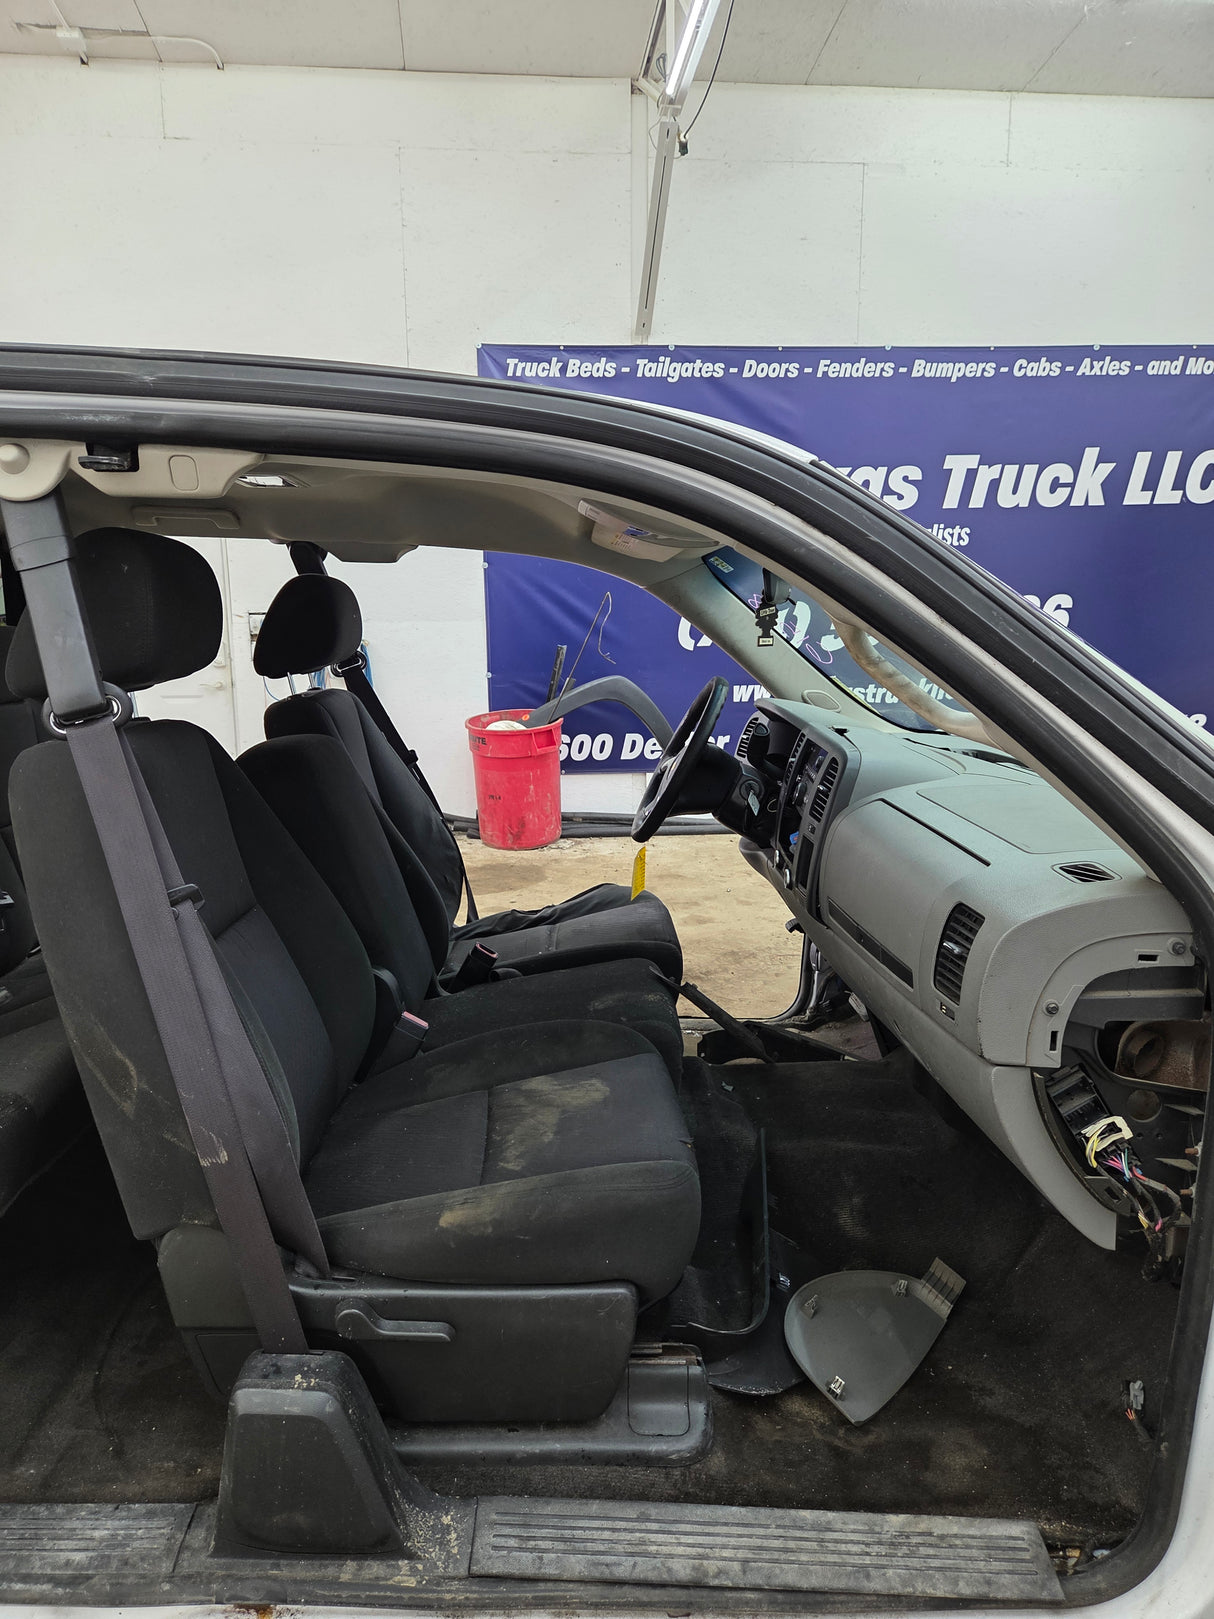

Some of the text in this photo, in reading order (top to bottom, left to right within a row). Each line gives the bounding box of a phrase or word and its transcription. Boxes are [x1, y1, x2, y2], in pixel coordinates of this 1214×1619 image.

[506, 357, 563, 378] Truck
[566, 357, 617, 378] Beds
[636, 356, 725, 383] Tailgates
[742, 359, 800, 378] Doors
[817, 358, 895, 378] Fenders
[911, 359, 996, 383] Bumpers
[1013, 357, 1062, 377] Cabs
[1076, 356, 1131, 376] Axles
[1147, 355, 1185, 375] and
[1185, 357, 1214, 375] Mo
[942, 446, 1117, 510] Truck
[1122, 448, 1214, 506] LLC
